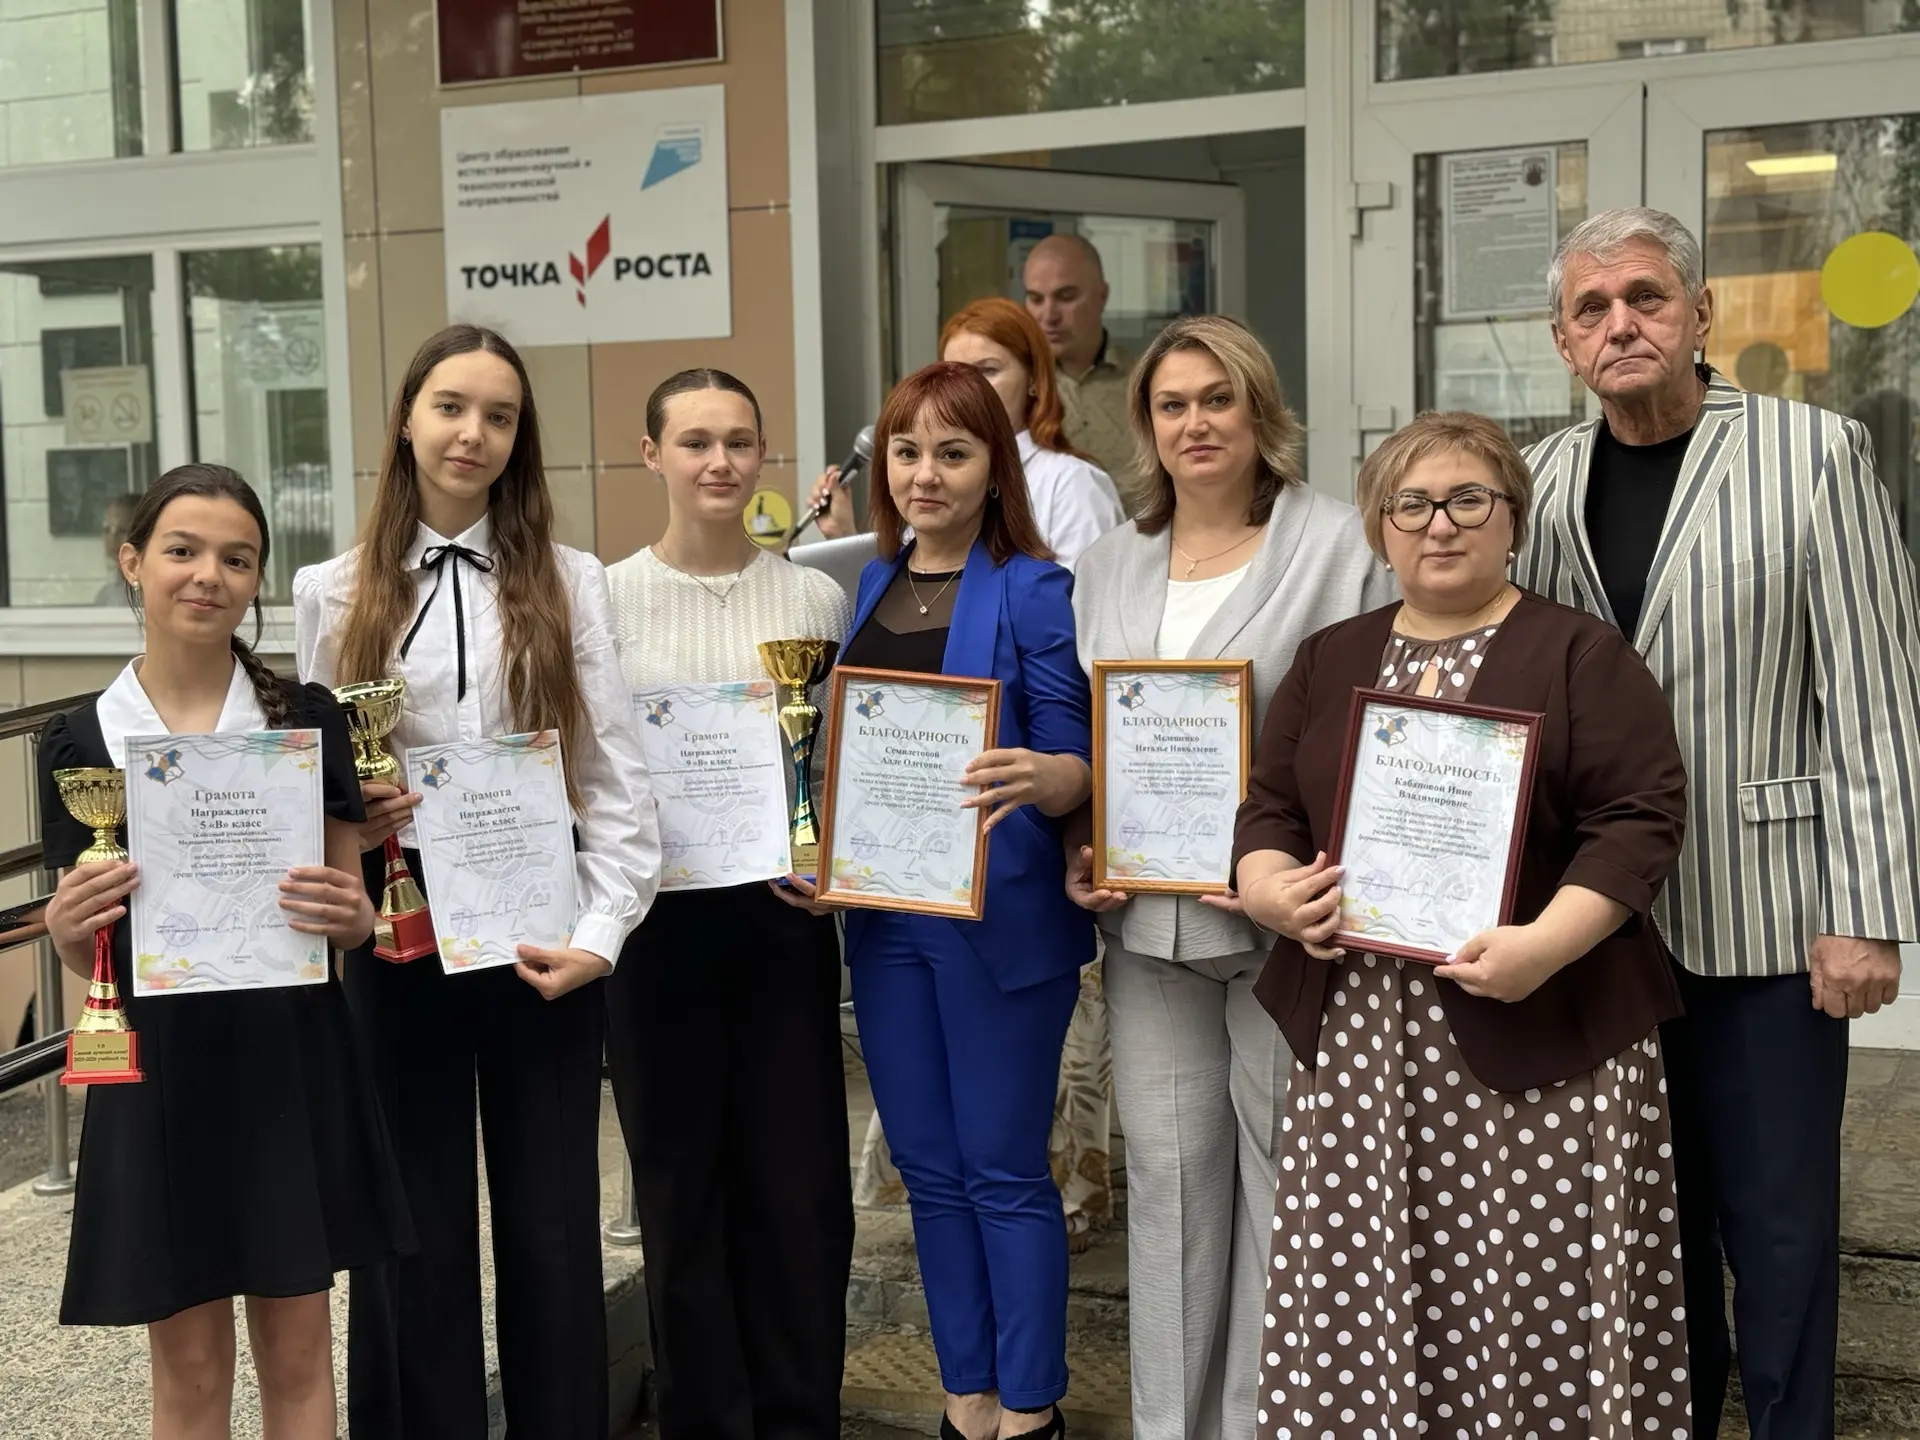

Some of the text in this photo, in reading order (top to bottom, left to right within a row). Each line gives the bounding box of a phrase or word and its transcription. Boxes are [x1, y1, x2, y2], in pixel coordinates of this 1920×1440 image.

[456, 146, 570, 164] Центр образования
[584, 159, 591, 167] и
[457, 175, 556, 192] технологической
[457, 190, 560, 209] направленностей
[461, 252, 711, 289] ТОЧКА РОСТА
[1122, 716, 1228, 729] БЛАГОДАРНОСТЬ
[684, 732, 730, 743] Грамота
[858, 725, 969, 745] БЛАГОДАРНОСТЬ
[680, 748, 737, 758] Награждается
[885, 746, 940, 758] Семилетовой
[1135, 744, 1218, 753] Наталье Николаевне
[881, 757, 943, 770] Алле Олеговне
[1375, 754, 1502, 783] БЛАГОДАРНОСТЬ
[1394, 777, 1473, 797] Кабановой Инне
[195, 789, 256, 803] Грамота
[462, 788, 512, 804] Грамота
[1398, 789, 1468, 808] Владимировне
[190, 808, 267, 819] Награждается
[459, 805, 521, 820] Награждается
[199, 819, 262, 829] 5 «В» класс
[492, 816, 517, 826] класс
